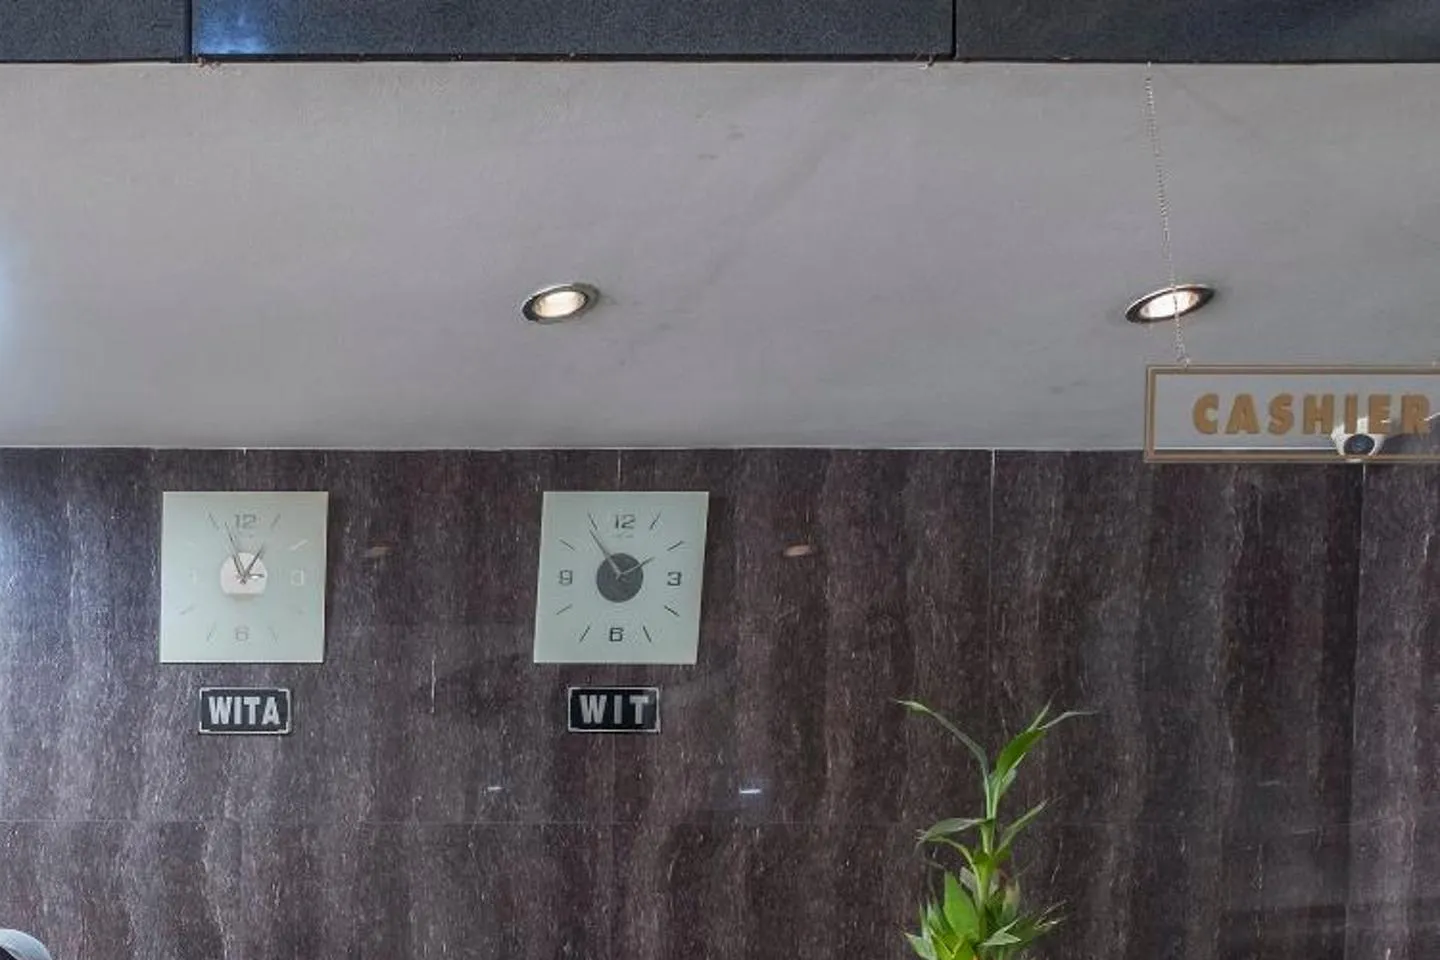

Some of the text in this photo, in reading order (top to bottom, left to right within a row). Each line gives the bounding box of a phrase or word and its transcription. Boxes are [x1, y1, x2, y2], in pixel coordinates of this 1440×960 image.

[1192, 392, 1432, 435] CASHIER
[233, 513, 257, 530] 12
[614, 513, 637, 530] 12
[558, 569, 574, 586] 9
[666, 571, 683, 587] 3
[234, 626, 250, 642] 6
[608, 627, 625, 643] 6
[208, 695, 281, 726] WITA
[578, 694, 650, 725] WIT
